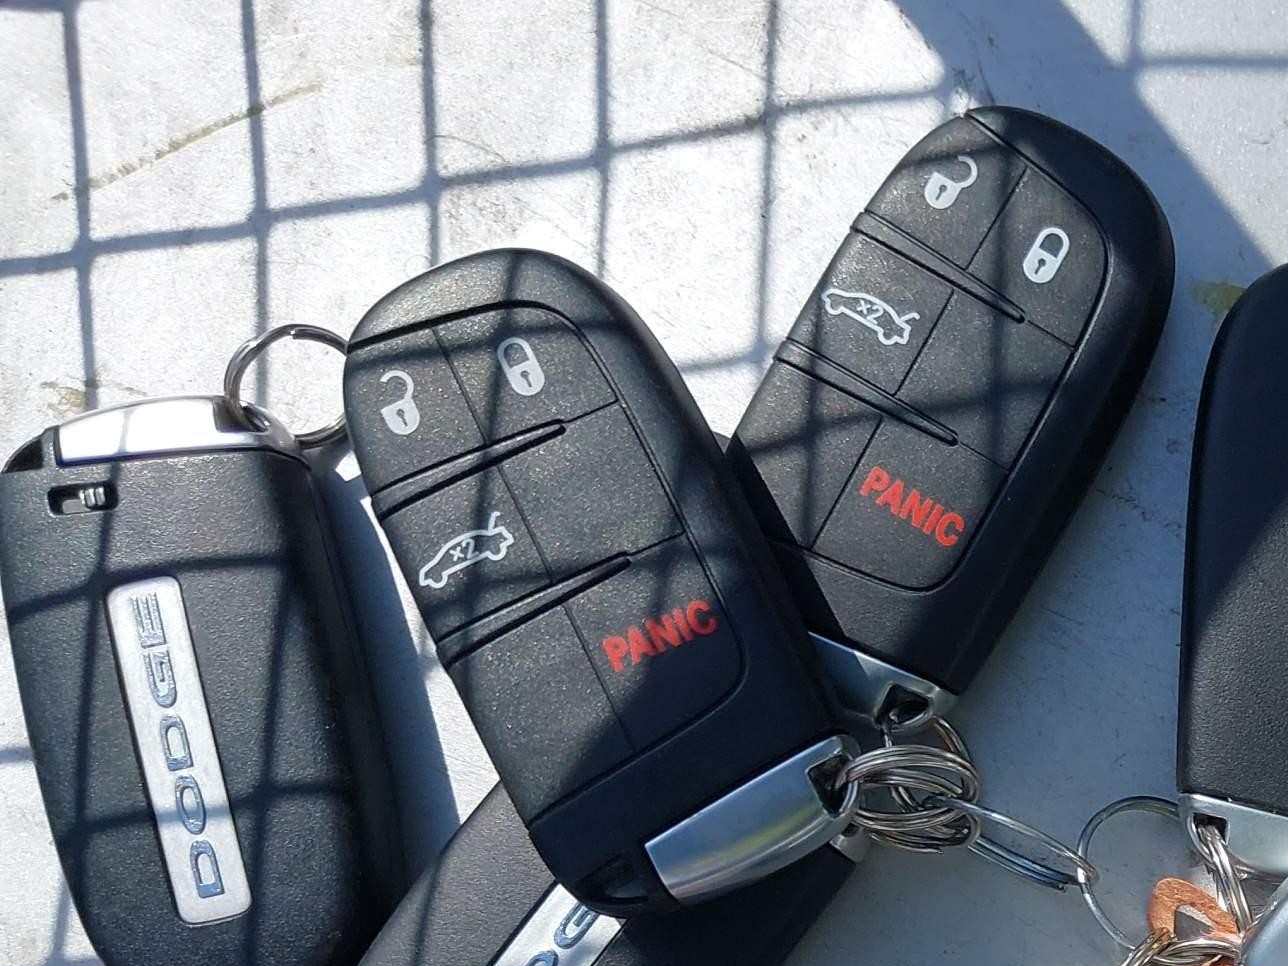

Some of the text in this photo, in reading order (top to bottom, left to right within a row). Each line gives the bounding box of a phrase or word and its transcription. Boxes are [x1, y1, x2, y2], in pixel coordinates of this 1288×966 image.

[859, 466, 966, 547] PANIC
[602, 599, 720, 672] PANIC
[131, 591, 226, 898] DODGE
